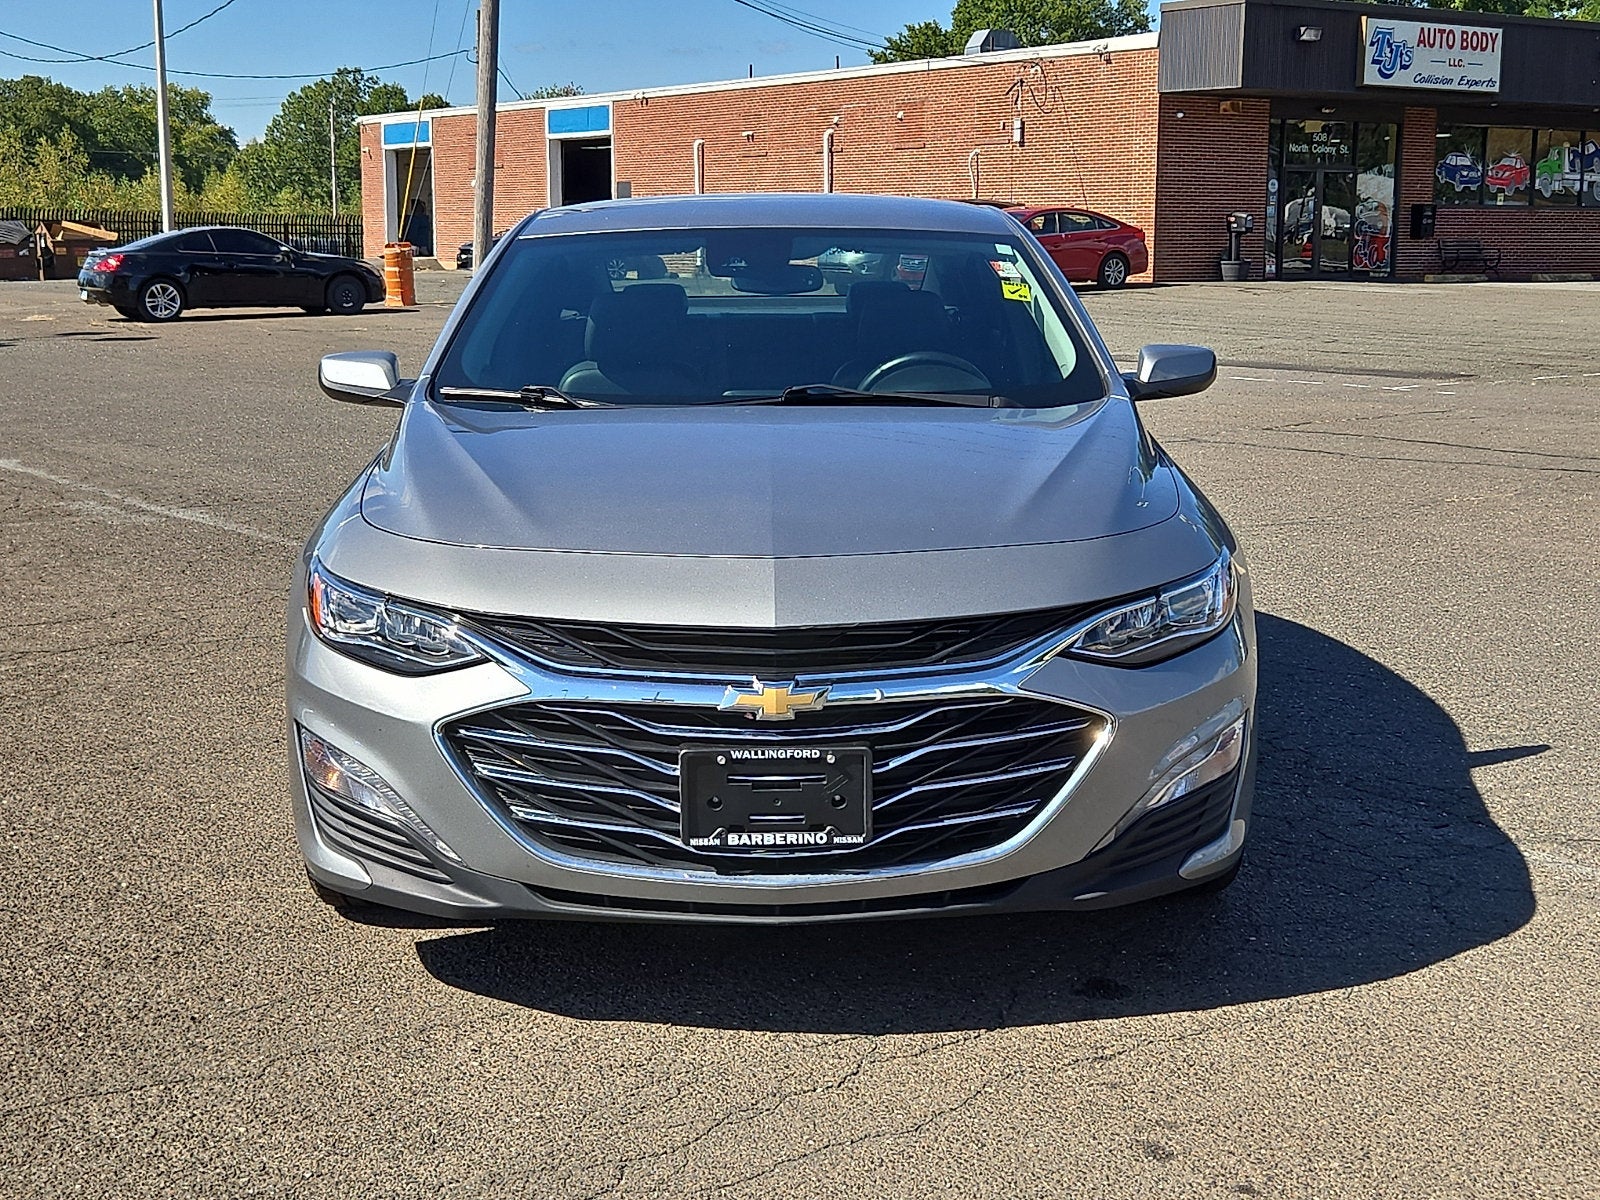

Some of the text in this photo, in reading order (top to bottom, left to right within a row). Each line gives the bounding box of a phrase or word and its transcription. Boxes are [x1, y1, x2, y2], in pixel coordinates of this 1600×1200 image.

[1369, 26, 1499, 80] TJ's AUTO BODY
[1448, 58, 1466, 68] LLC.
[1413, 72, 1497, 89] Collision Experts
[1312, 133, 1328, 142] 508
[1288, 143, 1309, 153] North
[1311, 144, 1337, 155] Colony
[730, 749, 821, 760] WALLINGFORD
[689, 833, 864, 847] NISSAN BARBERINO NISSAN
